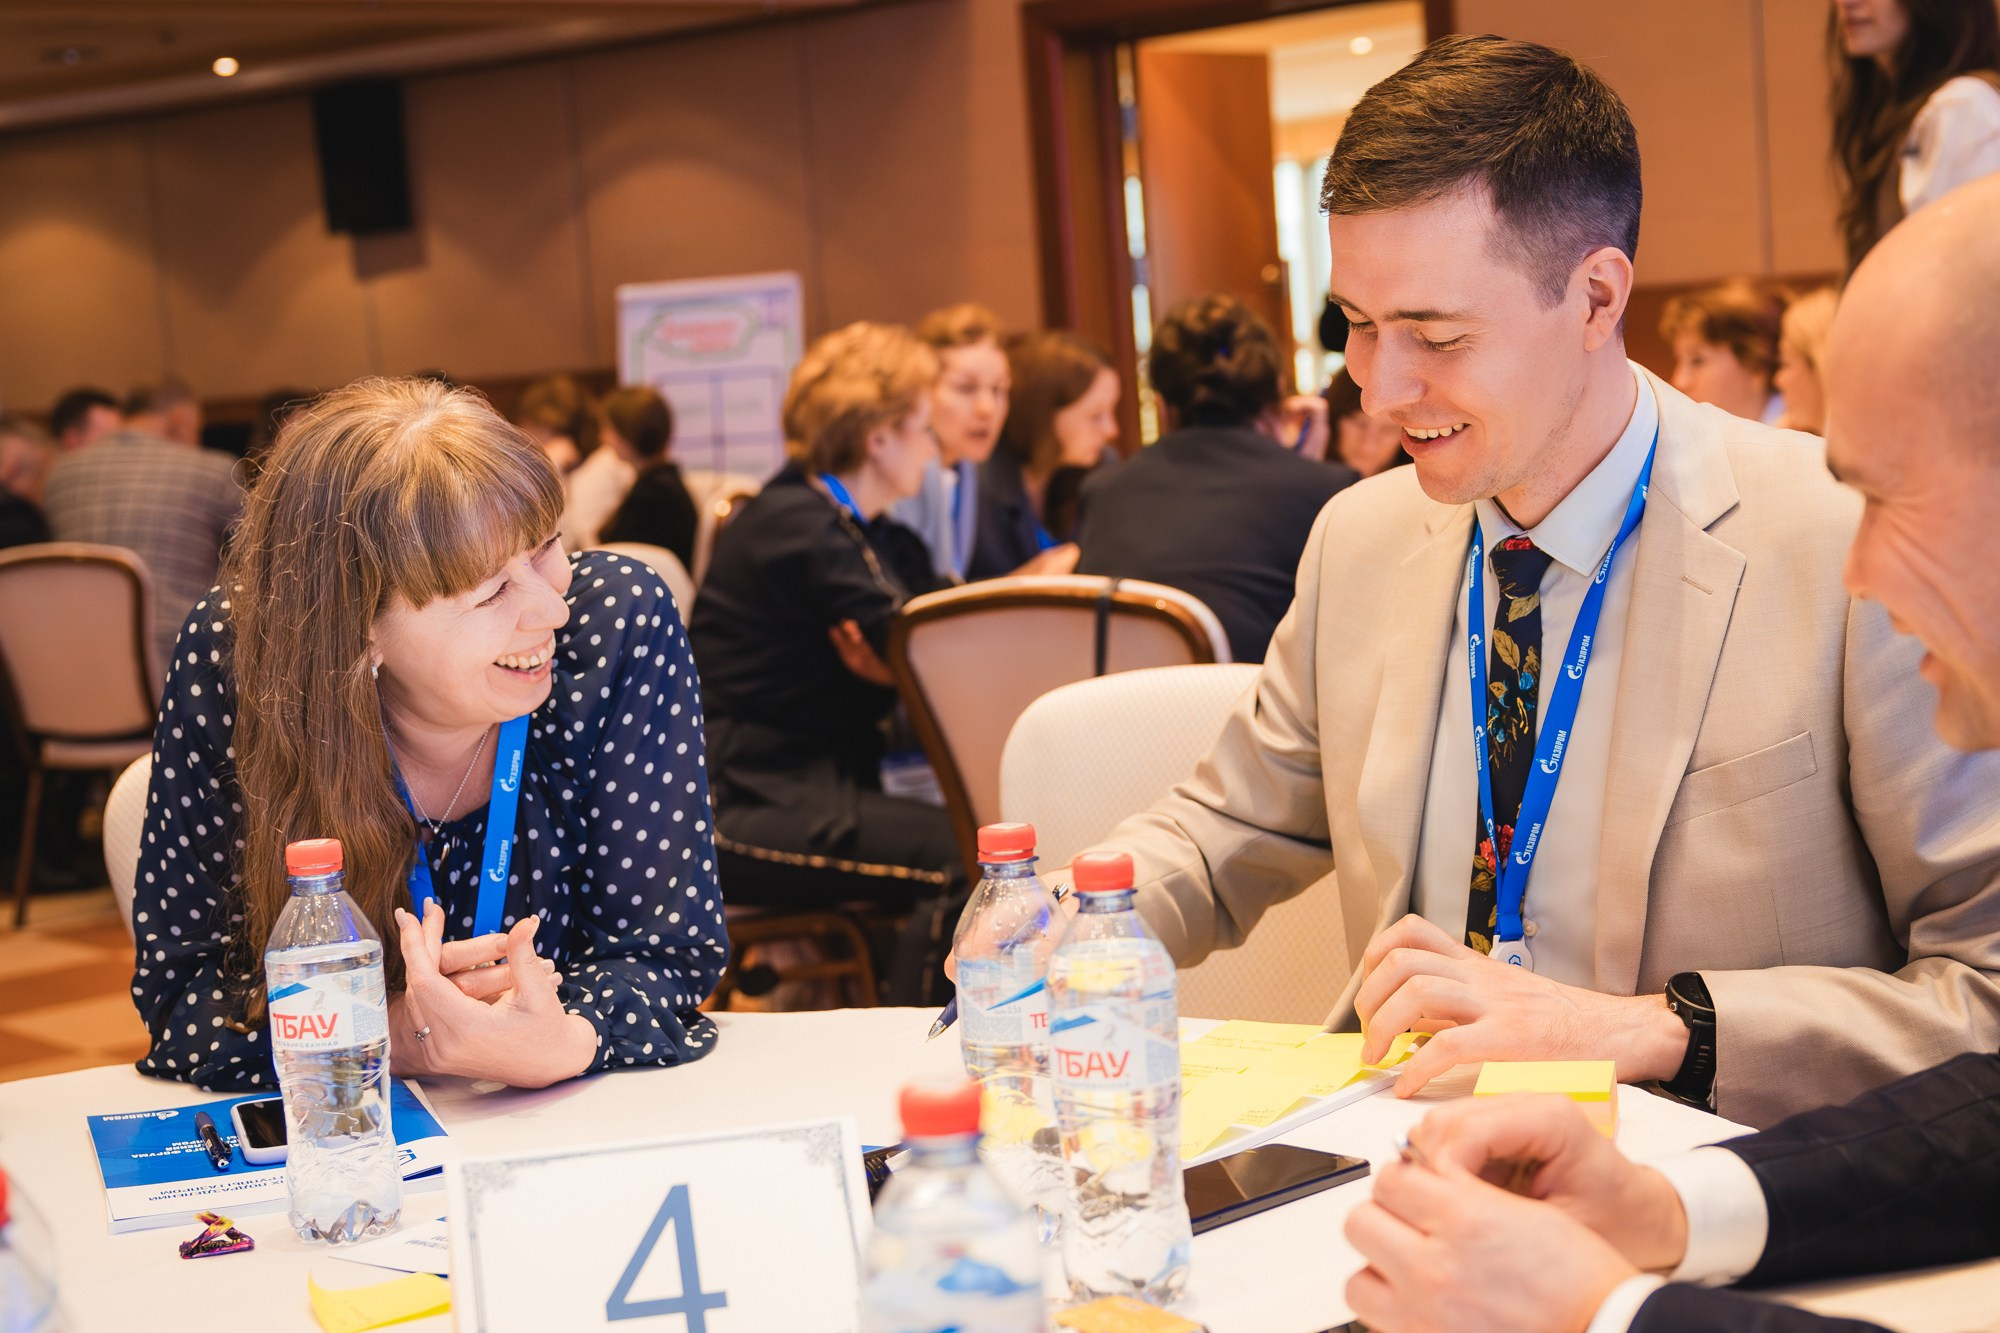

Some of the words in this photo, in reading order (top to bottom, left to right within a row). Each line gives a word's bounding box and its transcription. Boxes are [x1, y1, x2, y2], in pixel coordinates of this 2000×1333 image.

[272, 1012, 339, 1040] ТБАУ
[1054, 1047, 1130, 1079] ТБАУ
[131, 1149, 182, 1159] ФОРУМА
[605, 1183, 728, 1333] 4
